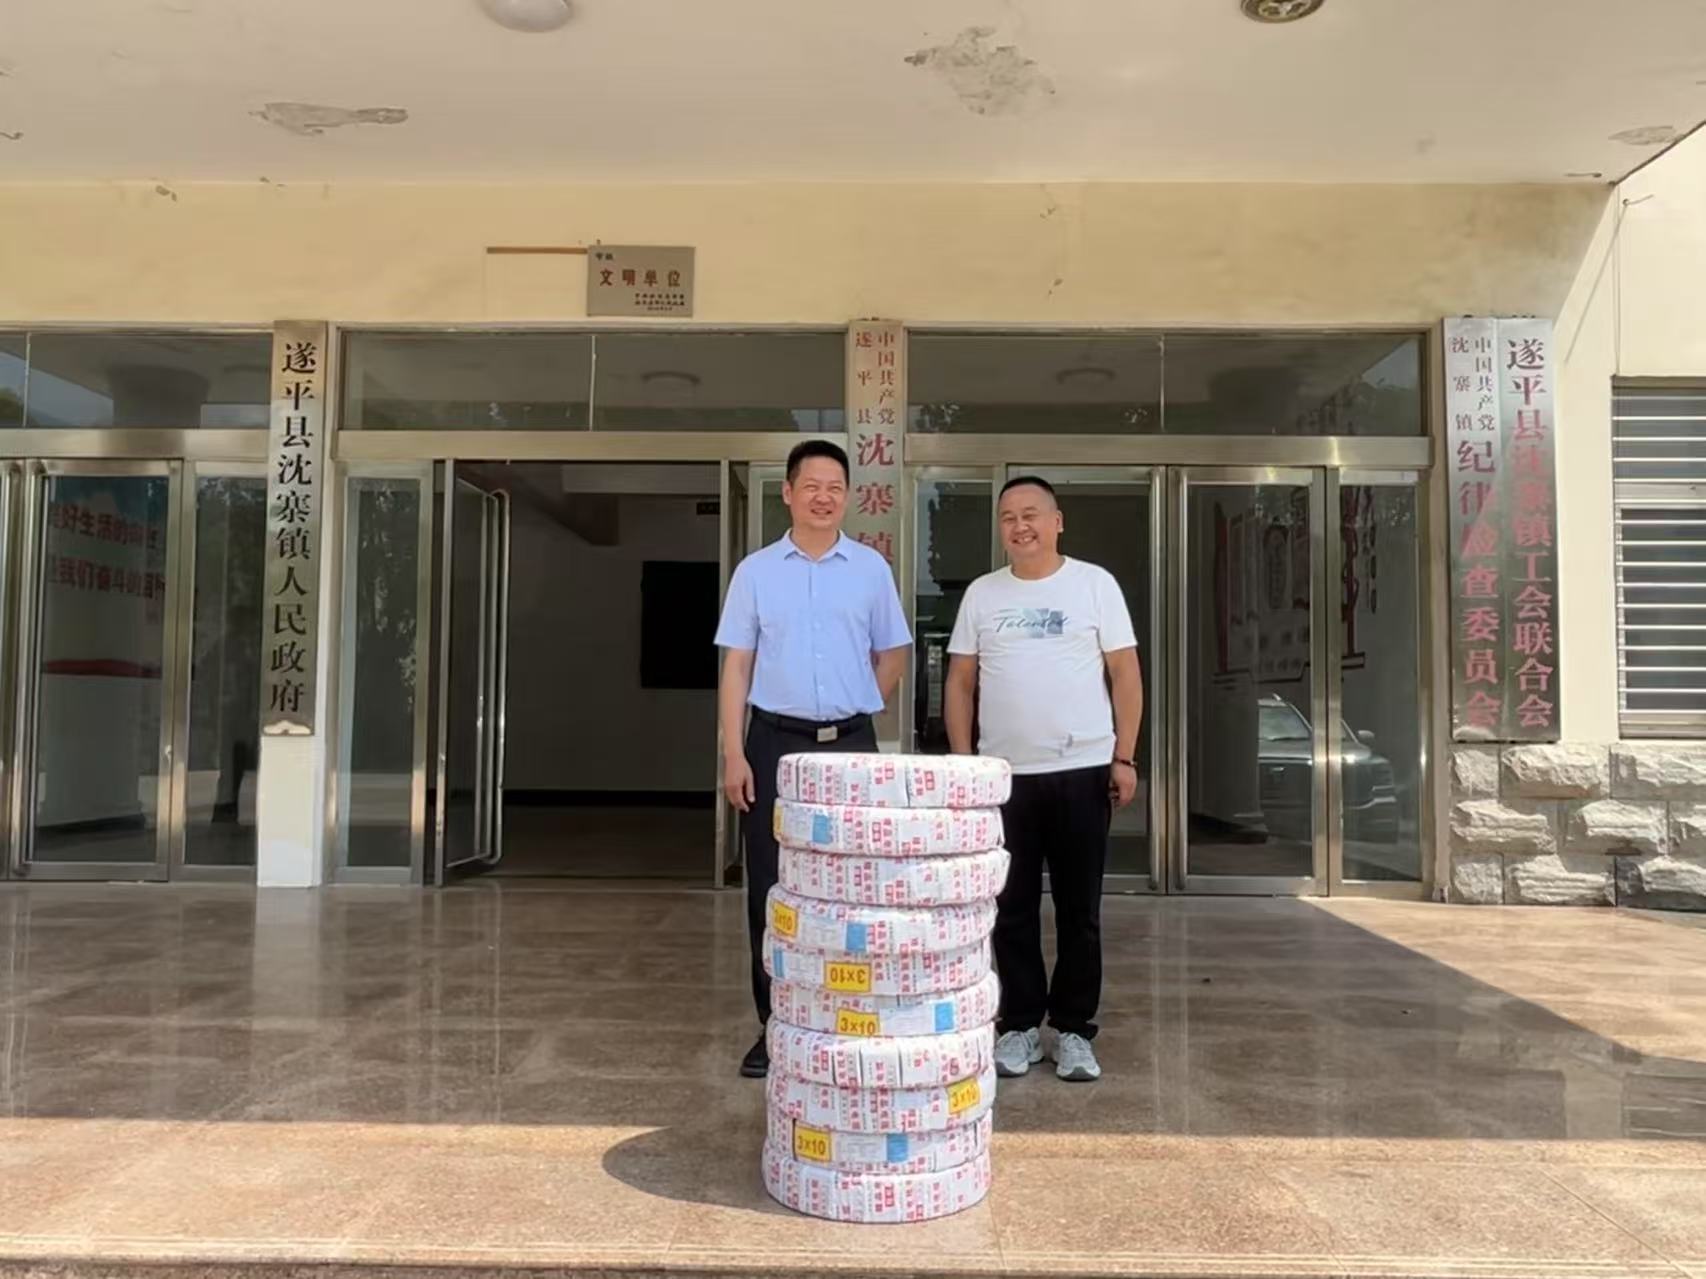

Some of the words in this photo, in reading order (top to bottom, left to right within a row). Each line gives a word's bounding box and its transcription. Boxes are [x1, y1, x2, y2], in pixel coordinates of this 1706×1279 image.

[599, 267, 681, 288] 文明单位
[855, 331, 873, 425] 遂平县
[877, 330, 896, 425] 中国共产党
[1474, 335, 1496, 432] 中国共产党
[270, 341, 317, 713] 遂平县沈寨镇人民政府
[1506, 338, 1554, 729] 遂平县沈寨镇工会联合会
[1456, 439, 1501, 728] 纪律检查委员会
